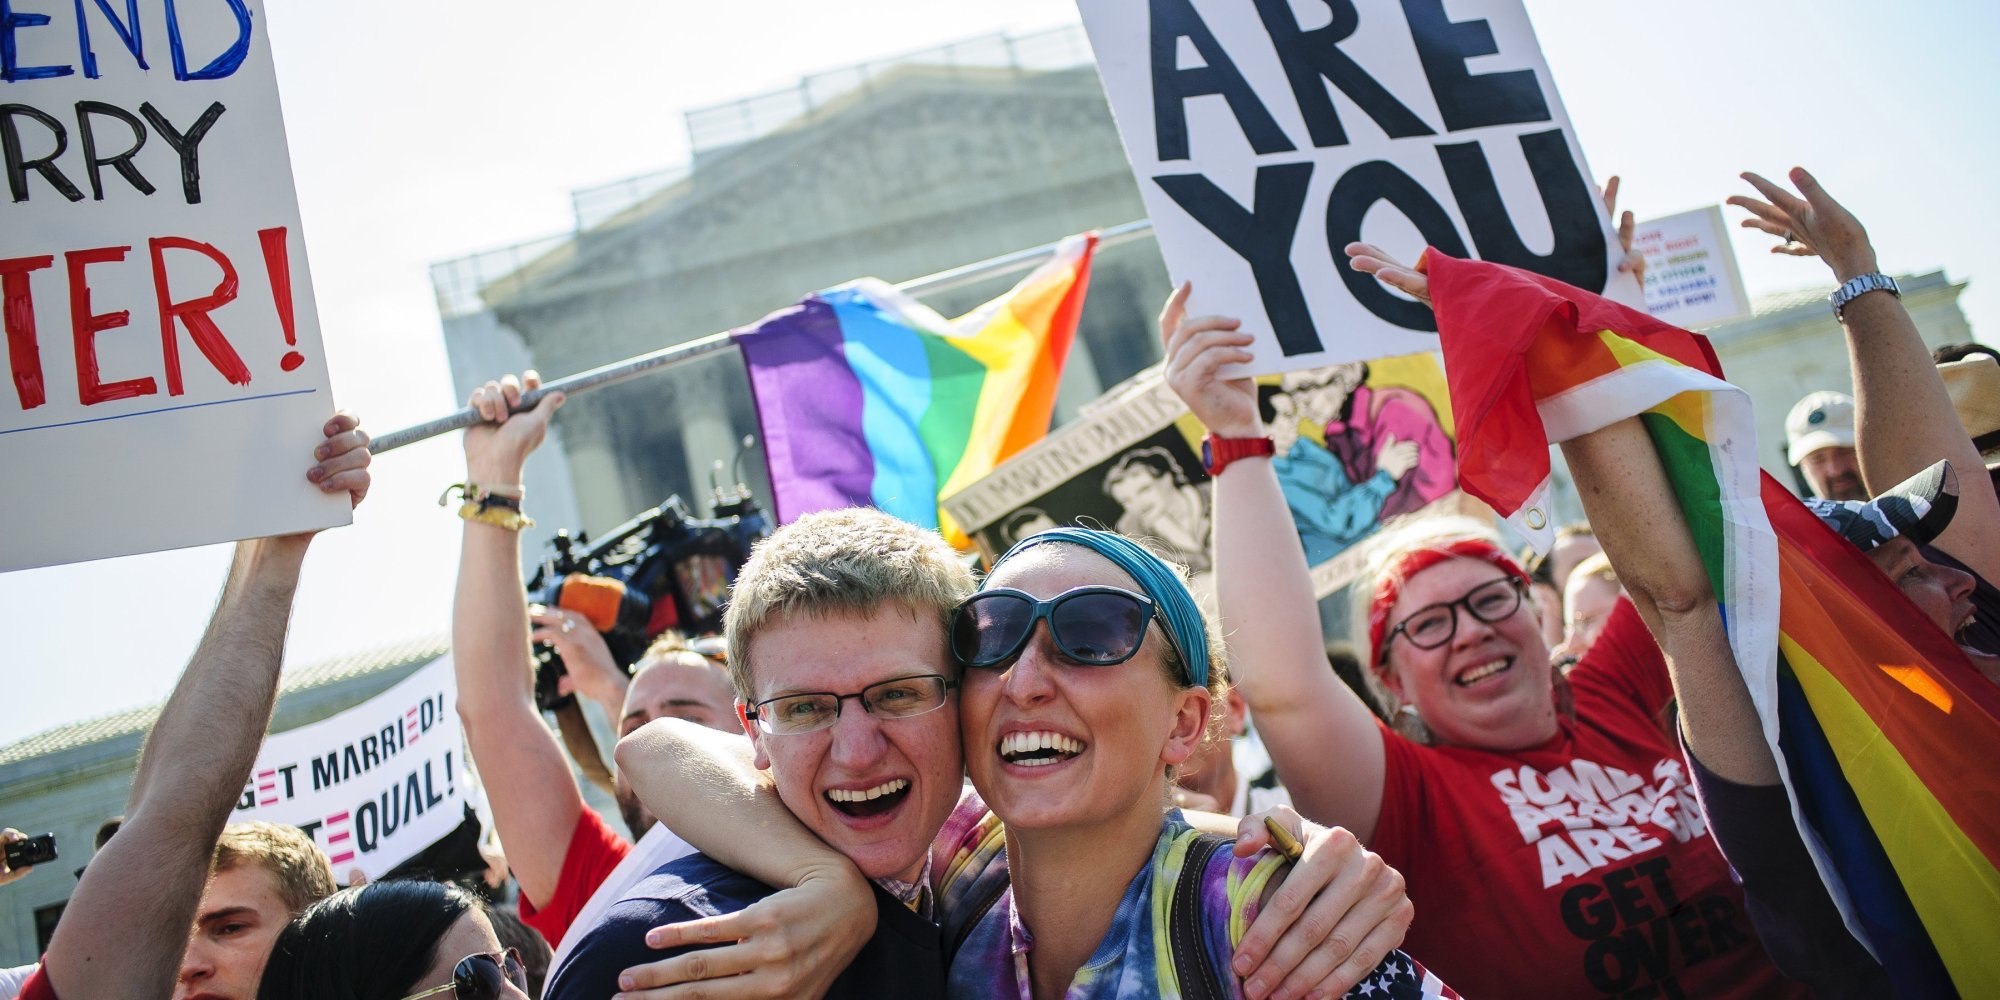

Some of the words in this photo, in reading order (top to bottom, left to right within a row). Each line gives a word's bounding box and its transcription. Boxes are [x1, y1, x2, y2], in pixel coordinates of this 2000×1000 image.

[0, 0, 253, 82] END
[1150, 0, 1551, 162] ARE
[0, 100, 226, 204] RRY
[1152, 128, 1608, 358] YOU
[0, 226, 305, 410] TER!
[987, 440, 1076, 504] MARTIN
[237, 764, 298, 810] GET
[311, 692, 444, 790] MARRIED!
[1490, 758, 1645, 806] SOME
[1536, 825, 1663, 890] ARE
[1650, 784, 1707, 843] GA
[1560, 855, 1681, 941] GET
[1583, 893, 1749, 997] OVER
